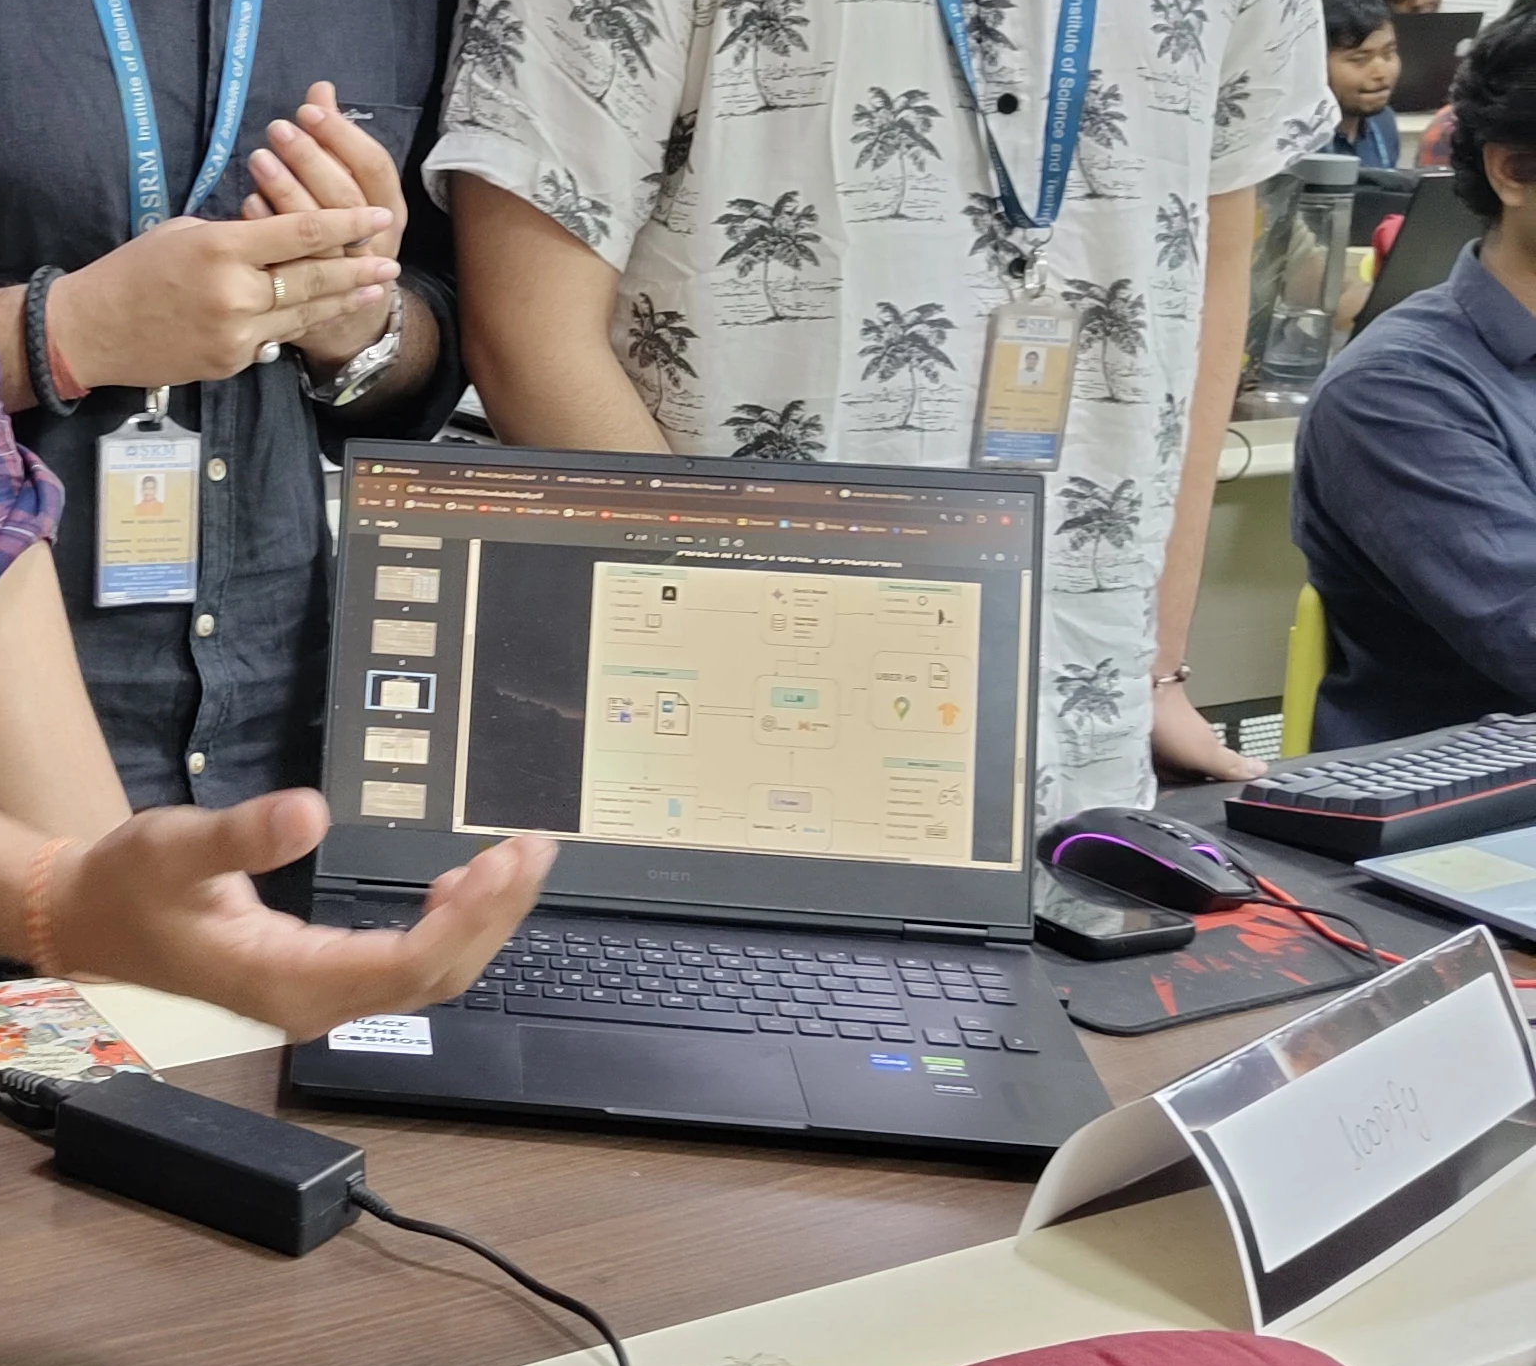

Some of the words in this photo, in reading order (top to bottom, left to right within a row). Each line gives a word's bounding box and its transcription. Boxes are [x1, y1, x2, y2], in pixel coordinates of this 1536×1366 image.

[121, 56, 139, 73] of
[1060, 58, 1076, 75] of
[129, 76, 152, 141] Institute
[1051, 77, 1075, 140] Science
[1048, 144, 1062, 172] and
[137, 148, 162, 209] SRM
[352, 1018, 411, 1028] HACK
[358, 1027, 403, 1036] THE
[333, 1034, 430, 1045] COSMOS
